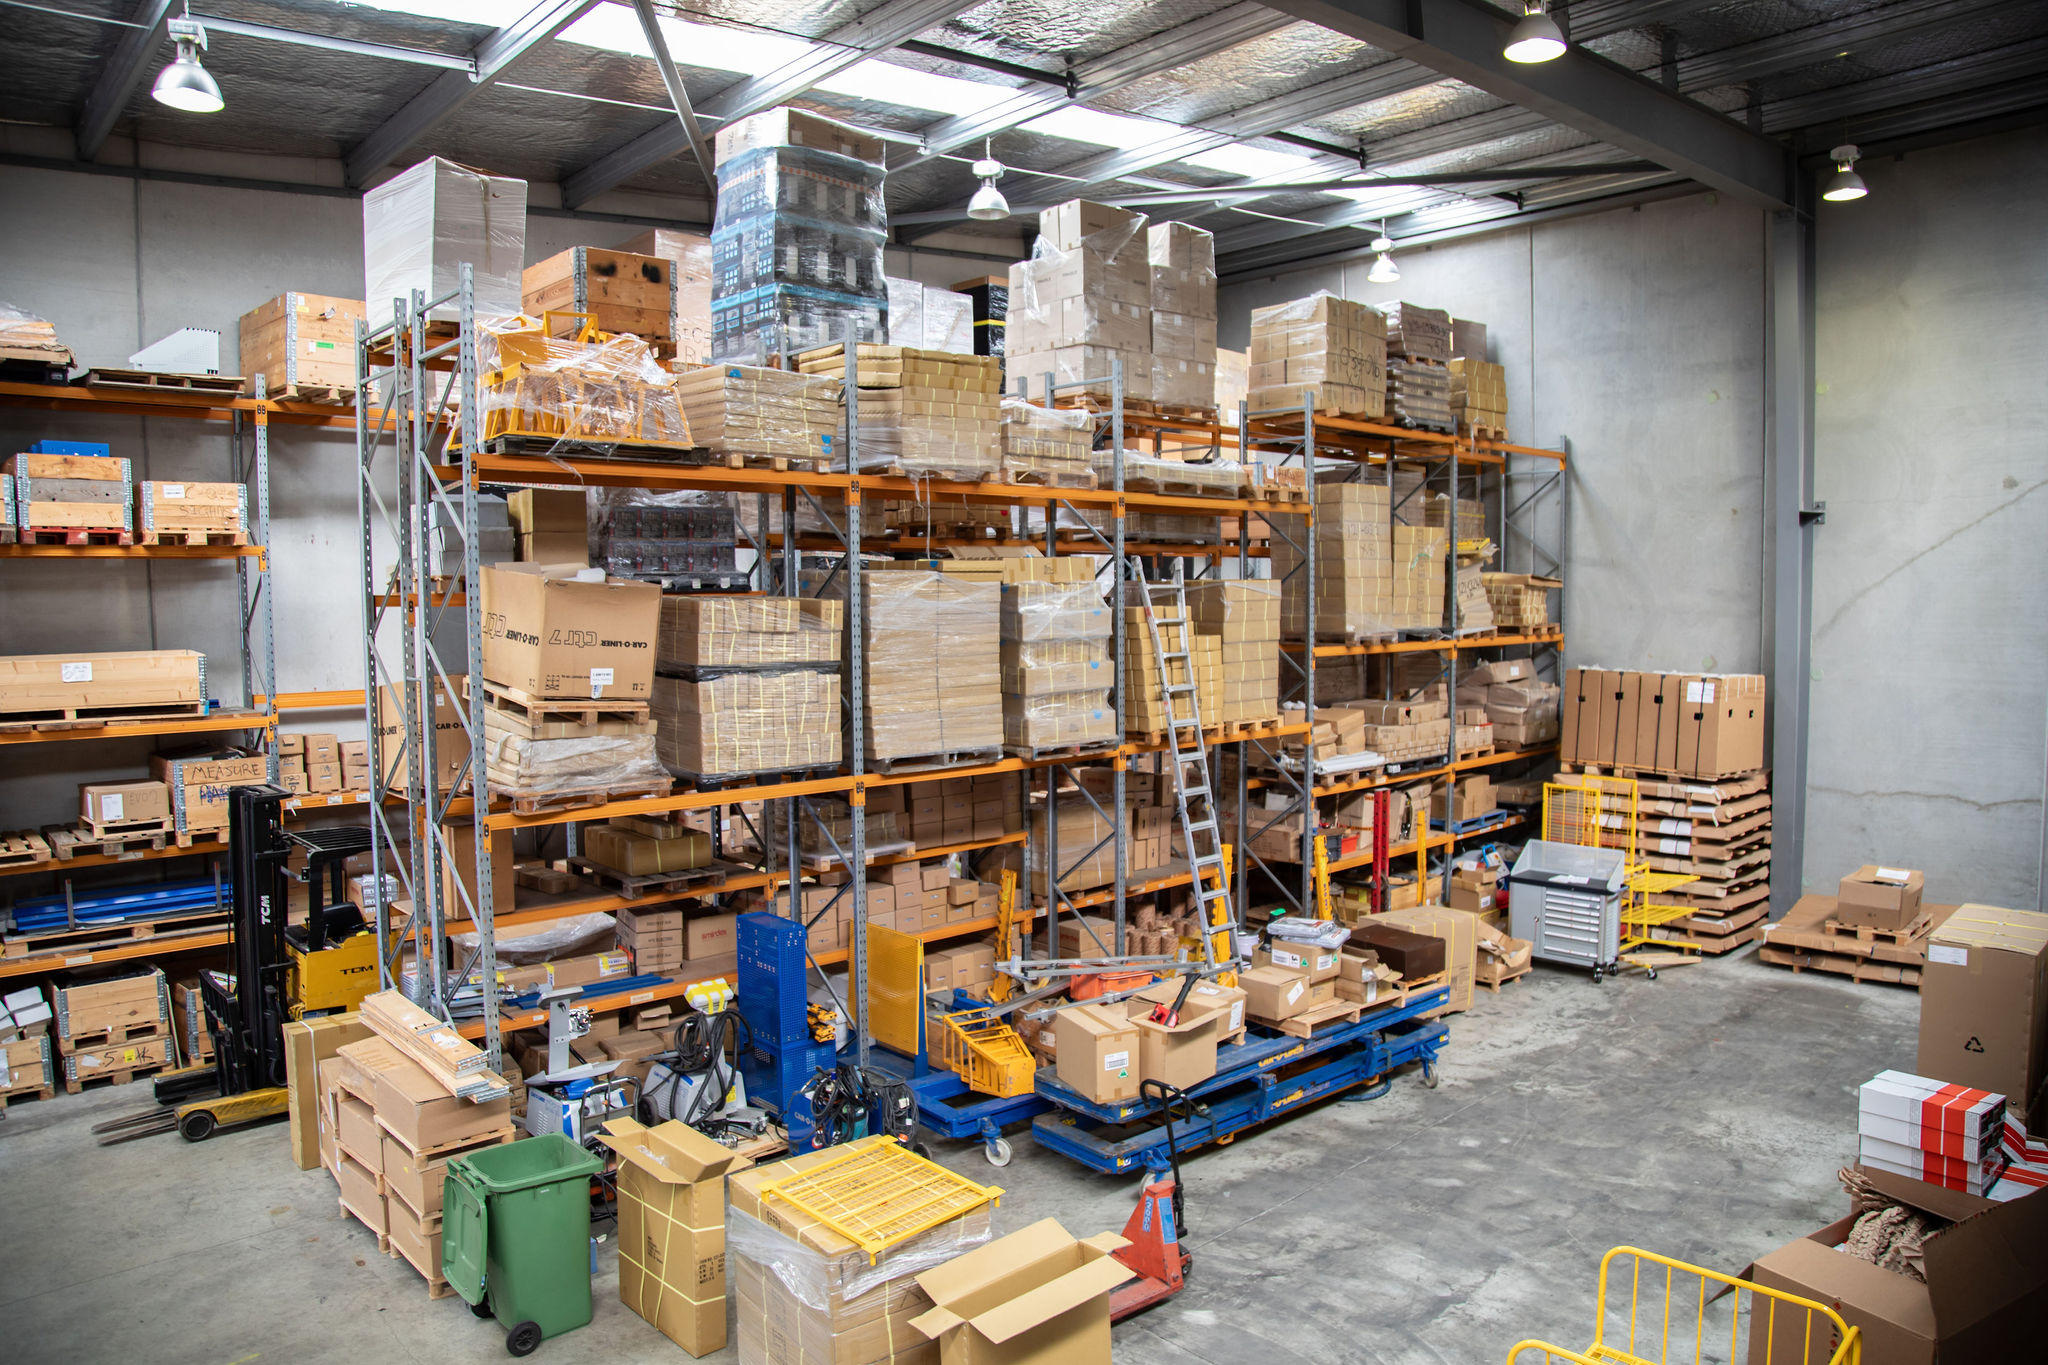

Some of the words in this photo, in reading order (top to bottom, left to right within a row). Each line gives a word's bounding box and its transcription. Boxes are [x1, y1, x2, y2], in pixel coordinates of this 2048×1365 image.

[506, 629, 540, 647] CAR-O-LINER
[549, 629, 562, 645] 7
[564, 630, 598, 648] ctr
[600, 639, 648, 649] CAR-O-LINER
[191, 764, 261, 780] MEASURE
[260, 895, 271, 926] TCM
[339, 965, 374, 975] TCM
